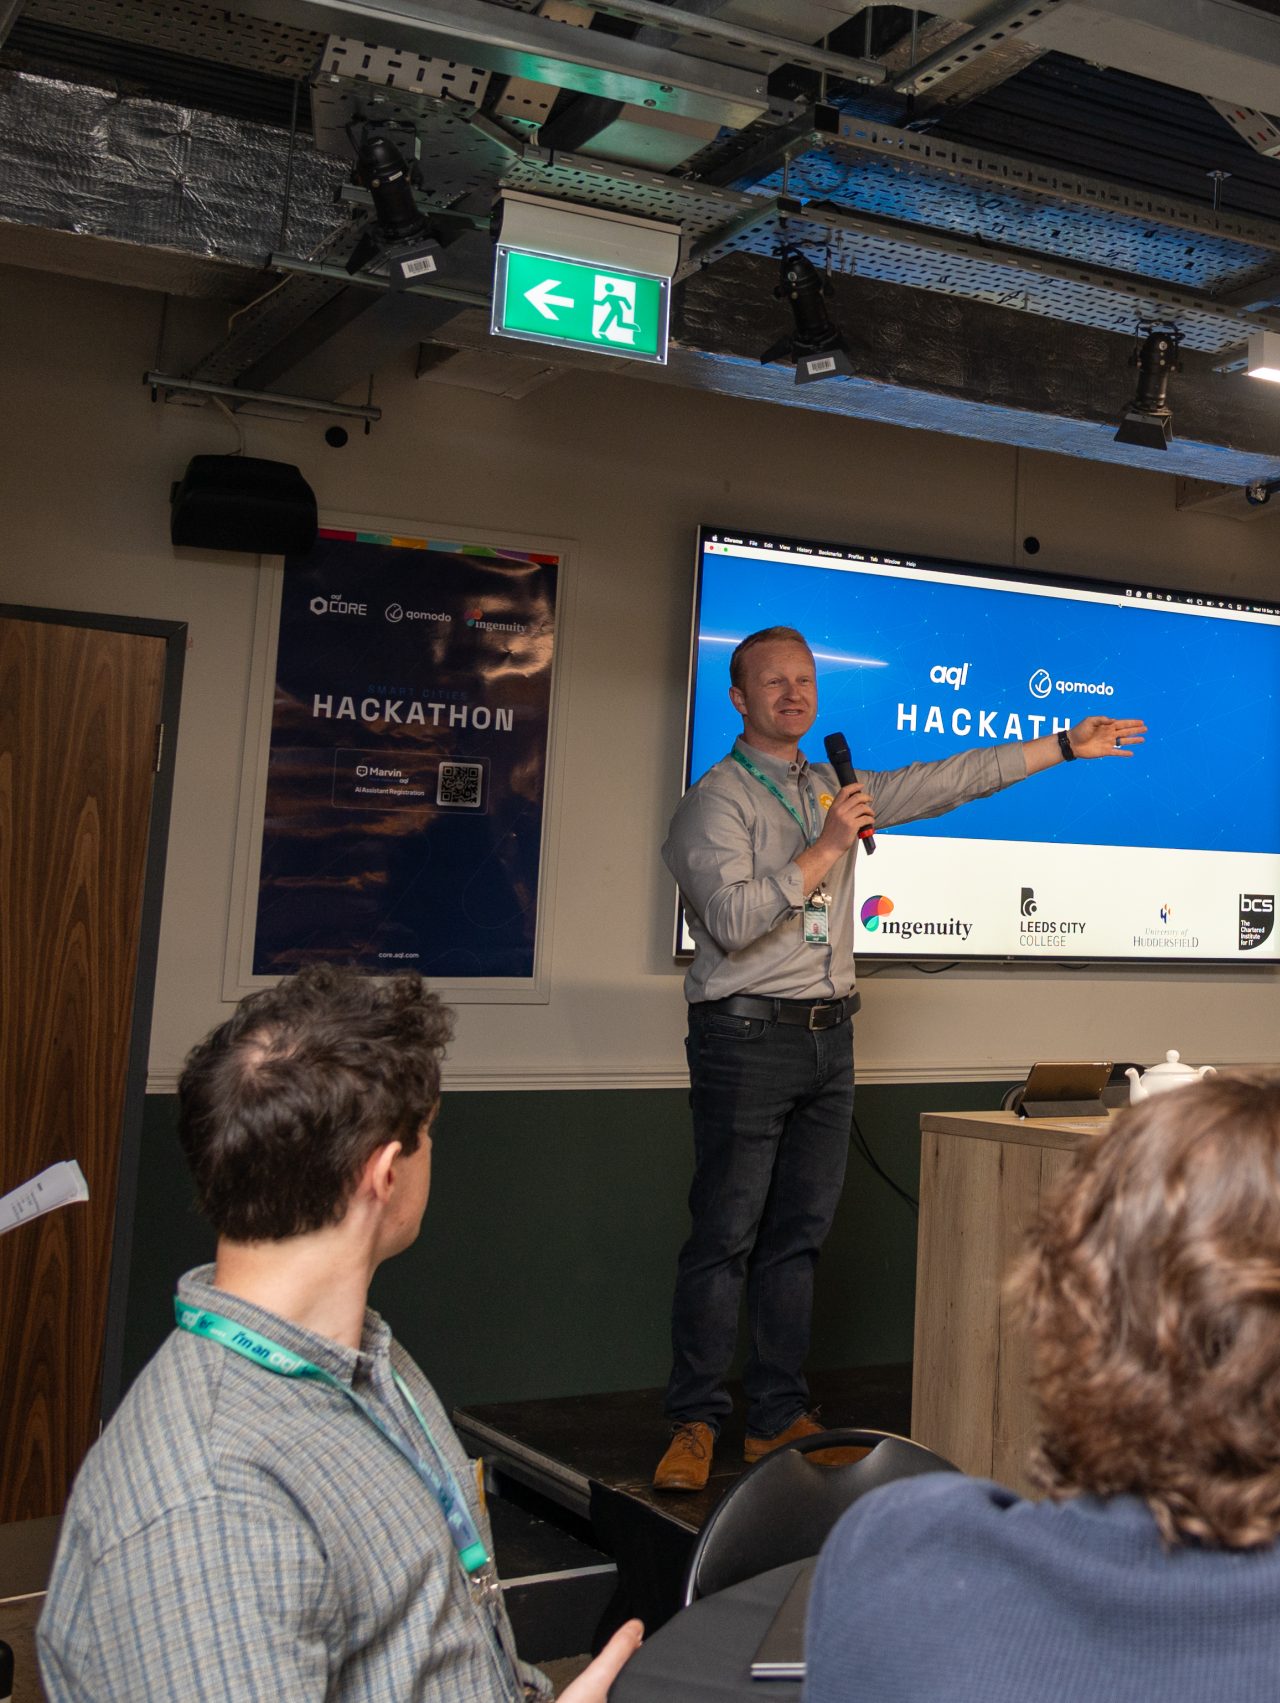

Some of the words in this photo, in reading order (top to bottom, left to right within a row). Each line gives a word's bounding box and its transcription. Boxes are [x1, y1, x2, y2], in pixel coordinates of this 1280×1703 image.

[723, 537, 743, 545] Chrome
[796, 546, 813, 554] History
[818, 549, 843, 558] Bookmarks
[848, 553, 865, 561] Profiles
[329, 601, 368, 616] CORE
[406, 610, 452, 622] qomodo
[474, 620, 527, 633] ingenuity
[929, 662, 969, 691] aql
[367, 684, 415, 697] SMART
[422, 688, 468, 700] CITIES
[1055, 679, 1114, 696] qomodo
[312, 694, 514, 732] HACKATHON
[896, 703, 1071, 741] HACKATH
[370, 767, 402, 778] Marvin
[389, 788, 425, 796] Registration
[882, 918, 973, 941] ingenuity
[1020, 921, 1056, 933] LEEDS
[1060, 922, 1086, 934] CITY
[1241, 919, 1250, 927] The
[1241, 926, 1265, 934] Chartered
[1019, 934, 1066, 947] COLLEGE
[251, 1344, 271, 1359] an
